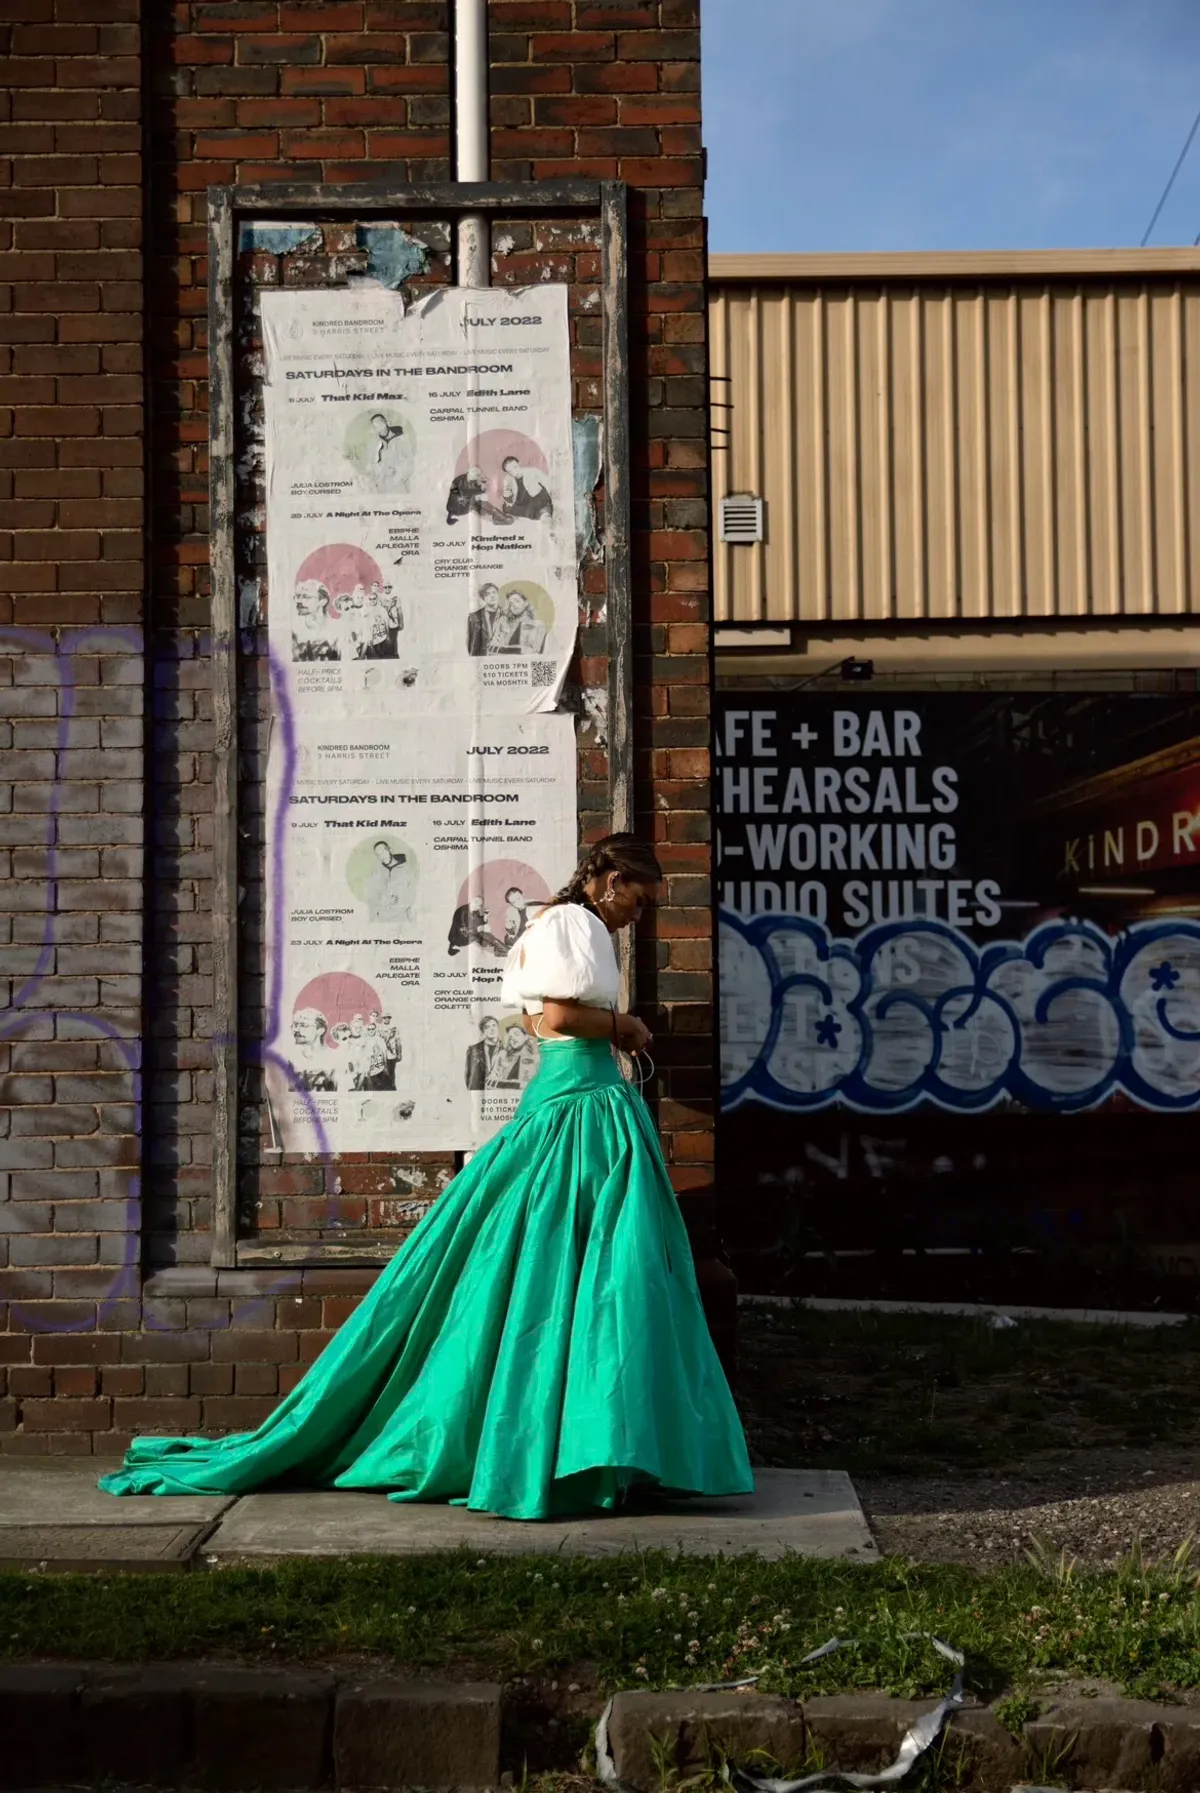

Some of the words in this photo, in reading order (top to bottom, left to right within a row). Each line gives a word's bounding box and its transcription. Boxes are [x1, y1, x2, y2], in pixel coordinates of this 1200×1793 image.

[312, 319, 343, 327] KINDRED
[459, 316, 496, 327] JULY
[500, 315, 542, 326] 2022
[319, 328, 350, 336] HARRIS
[285, 368, 373, 380] SATURDAYS
[376, 368, 391, 377] IN
[394, 367, 423, 376] THE
[425, 364, 513, 376] BANDROOM
[321, 393, 350, 402] That
[353, 393, 375, 402] Kid
[466, 389, 498, 398] Edith
[500, 389, 531, 397] Lane
[429, 407, 464, 415] CARPAL
[335, 510, 360, 519] Night
[391, 509, 422, 518] Opera
[375, 542, 420, 550] APLEGATE
[471, 543, 494, 552] Hop
[495, 542, 532, 551] Nation
[400, 549, 420, 557] ORA
[434, 571, 471, 579] COLETTE
[297, 676, 343, 685] COCKTAILS
[496, 679, 529, 687] MOSHTIX
[297, 685, 325, 694] BEFORE
[715, 710, 778, 757] FE
[833, 710, 922, 757] BAR
[466, 746, 503, 755] JULY
[507, 745, 549, 755] 2022
[325, 752, 355, 760] HARRIS
[358, 752, 390, 760] STREET
[715, 765, 959, 814] HEARSALS
[288, 795, 378, 805] SATURDAYS
[380, 795, 395, 804] IN
[398, 794, 428, 804] THE
[430, 793, 520, 804] BANDROOM
[323, 820, 354, 828] That
[356, 819, 378, 828] Kid
[380, 819, 408, 828] Maz
[471, 818, 503, 826] Edith
[504, 818, 537, 826] Lane
[470, 835, 505, 843] TUNNEL
[717, 822, 957, 871] -WORKING
[717, 880, 827, 926] UDIO
[842, 879, 1001, 927] SUITES
[471, 975, 495, 983] Hop
